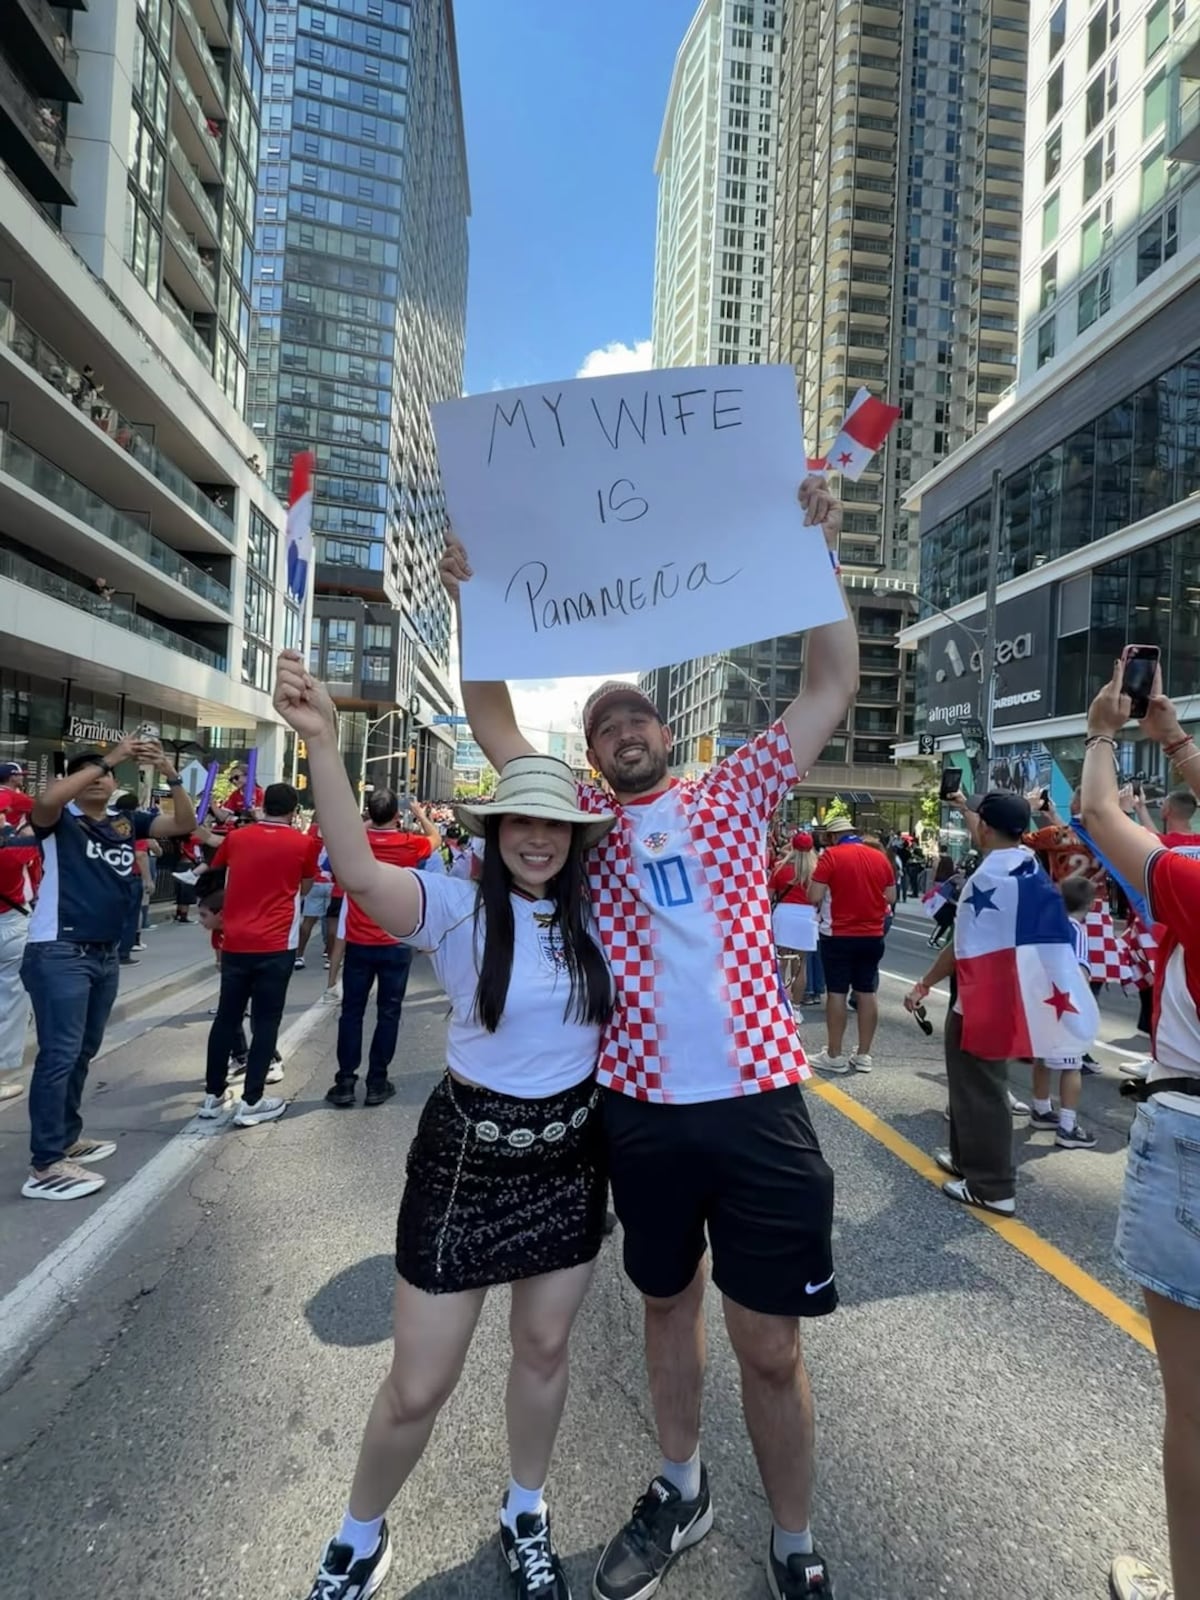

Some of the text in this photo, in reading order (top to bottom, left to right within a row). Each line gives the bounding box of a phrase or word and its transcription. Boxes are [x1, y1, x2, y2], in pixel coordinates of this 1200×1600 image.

[487, 389, 744, 465] MY WIFE
[596, 478, 649, 524] IS
[928, 701, 972, 726] almana
[991, 688, 1042, 711] ARBUCKS
[642, 855, 694, 907] 10
